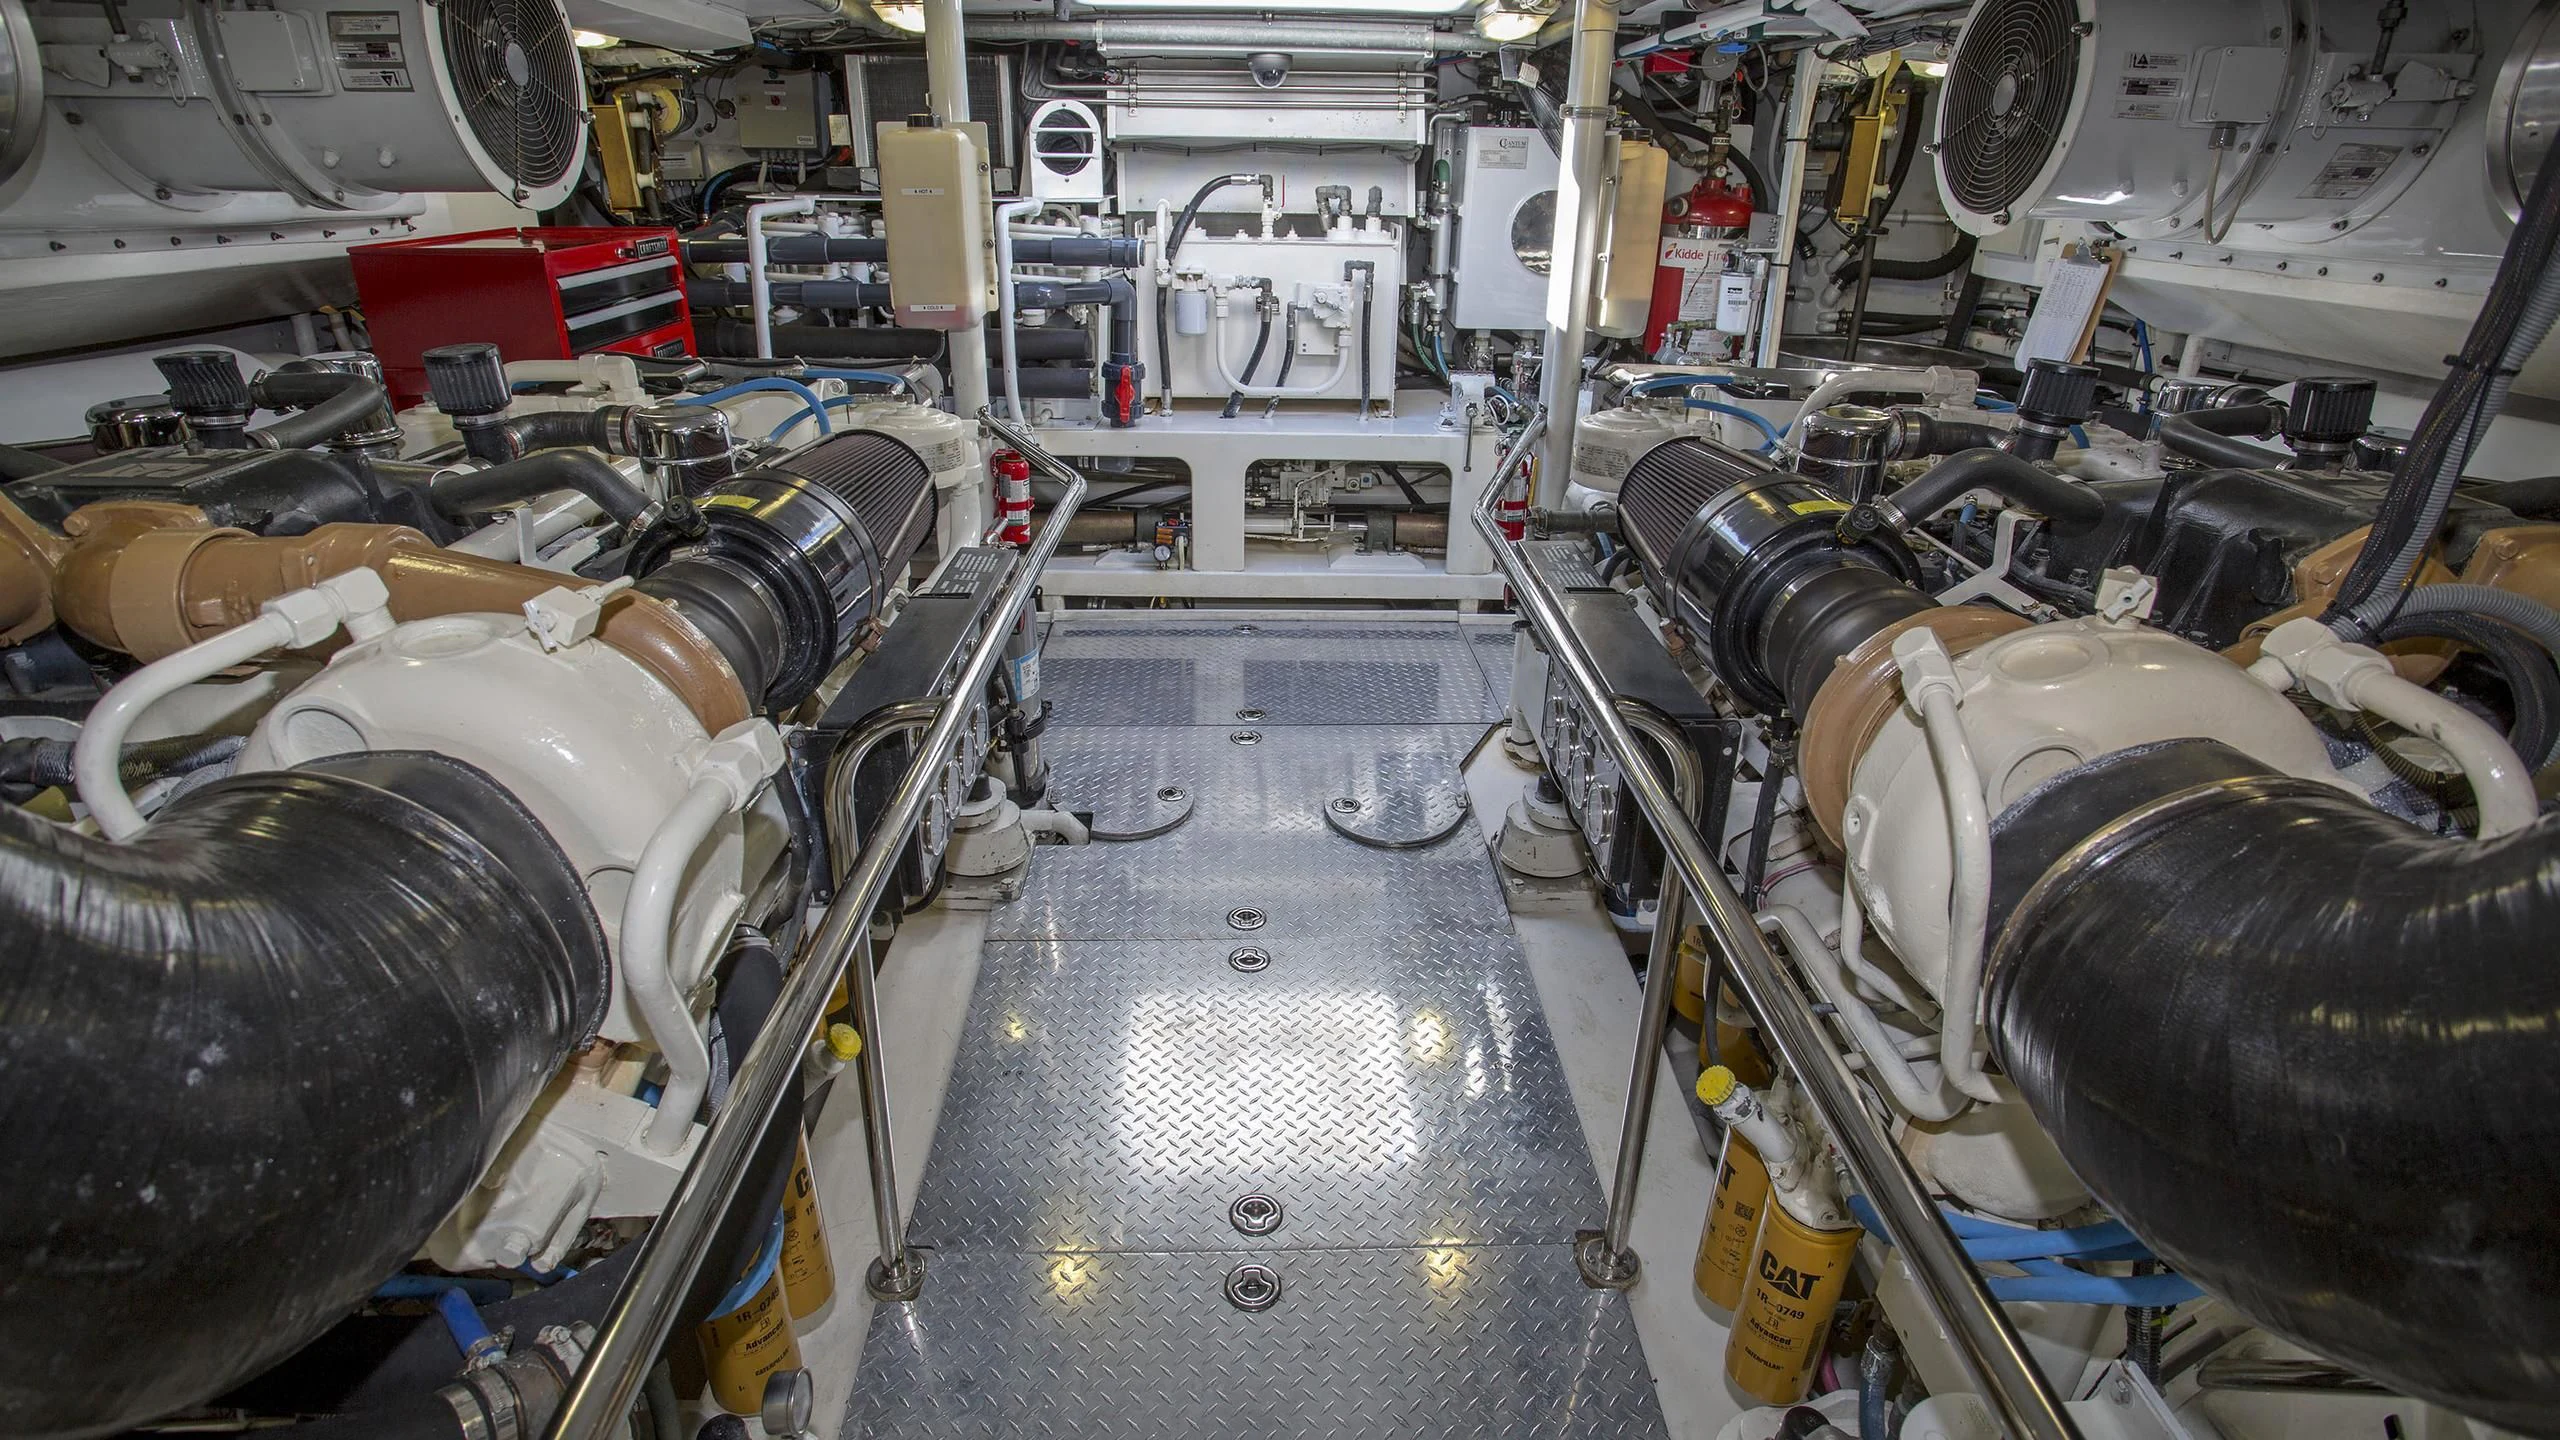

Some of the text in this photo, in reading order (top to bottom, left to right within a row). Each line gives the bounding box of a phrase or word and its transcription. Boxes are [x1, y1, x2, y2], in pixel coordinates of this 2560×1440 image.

[640, 240, 668, 254] CRAFTSMAN
[1675, 248, 1704, 260] Kidde
[1760, 1250, 1823, 1300] CAT
[1756, 1288, 1805, 1320] 1R-0749
[745, 1318, 784, 1352] Advanced
[1750, 1318, 1792, 1345] Advanced
